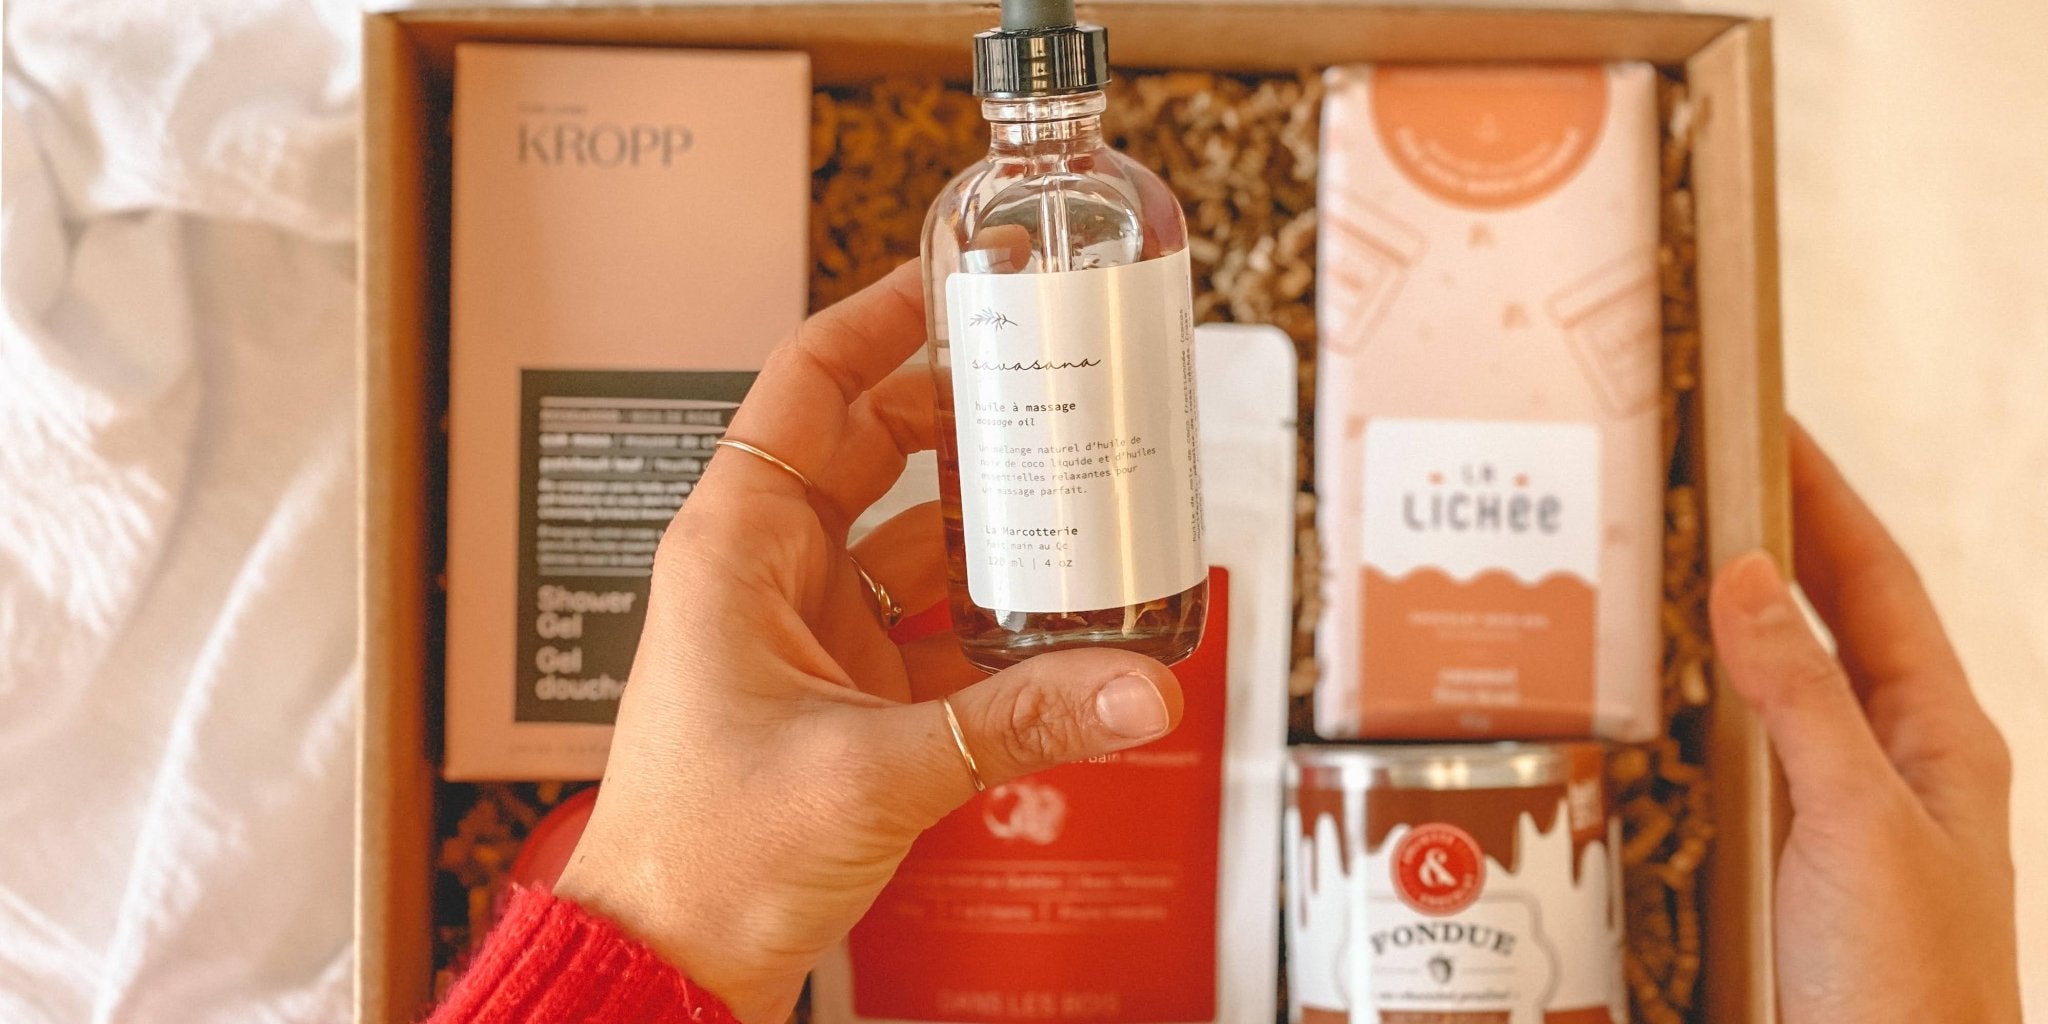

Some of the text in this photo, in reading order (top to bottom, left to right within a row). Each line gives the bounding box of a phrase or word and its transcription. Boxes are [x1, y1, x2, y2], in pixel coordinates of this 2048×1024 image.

[517, 121, 695, 169] KROPP
[972, 357, 1102, 371] savasana
[975, 401, 1076, 414] huile à massage
[1018, 417, 1035, 426] oil
[1038, 444, 1080, 454] naturel
[1130, 436, 1142, 445] de
[1021, 460, 1045, 468] coco
[1051, 457, 1093, 469] liquide
[1098, 455, 1110, 464] et
[1115, 447, 1157, 460] d'huiles
[1051, 469, 1112, 481] relaxantes
[1116, 465, 1138, 477] pour
[1002, 525, 1079, 537] Marcotterie
[1010, 541, 1034, 550] main
[1010, 557, 1025, 568] ml
[1044, 558, 1051, 568] 4
[1058, 559, 1073, 568] oz
[537, 585, 636, 613] Shower
[536, 611, 583, 639] Gel
[535, 646, 583, 674] Gel
[535, 673, 628, 701] douch
[1371, 921, 1518, 957] FONDUE
